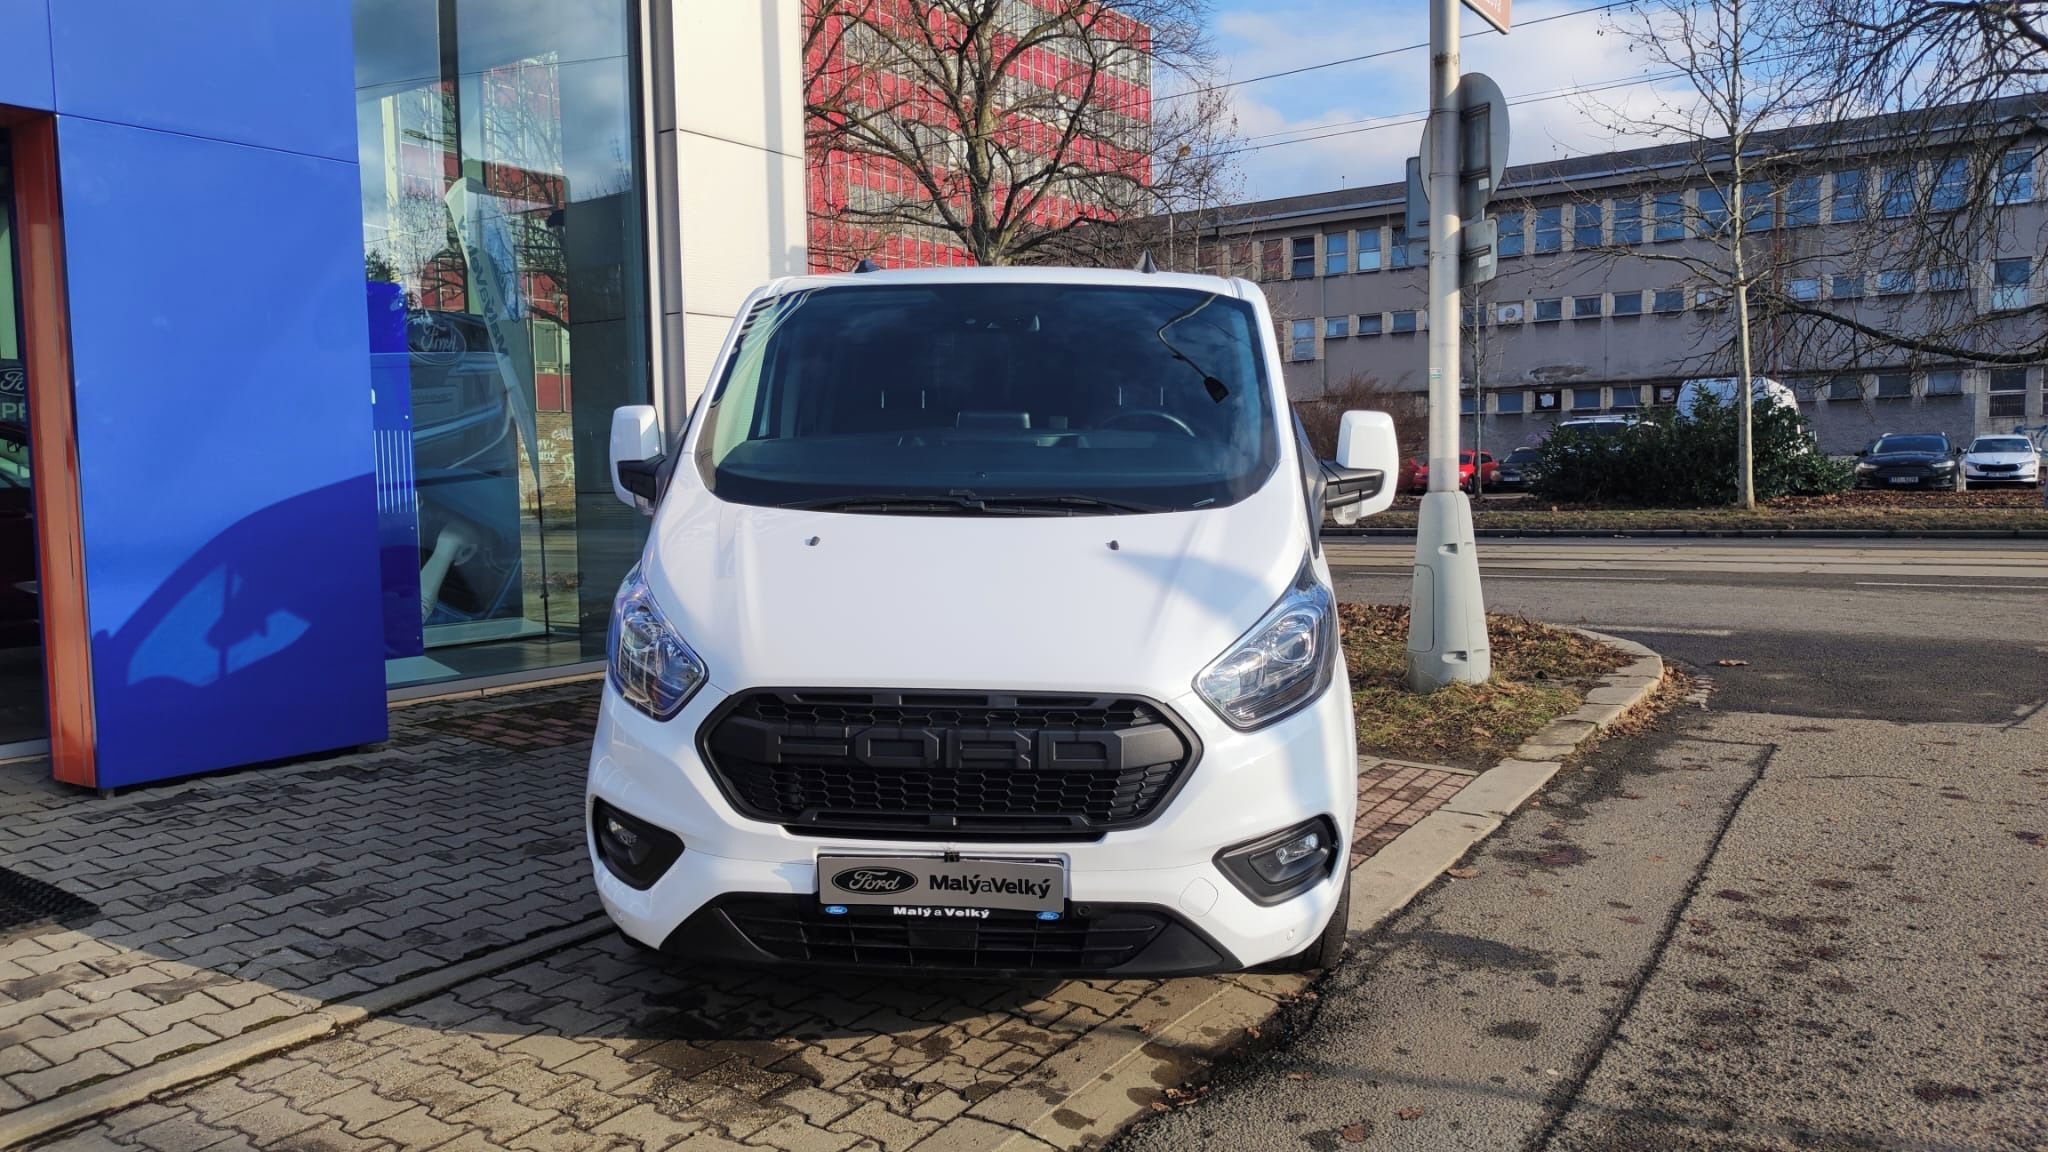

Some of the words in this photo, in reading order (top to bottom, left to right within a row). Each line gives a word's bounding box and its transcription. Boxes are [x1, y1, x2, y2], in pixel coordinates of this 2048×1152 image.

[766, 727, 1122, 769] FORD
[849, 870, 900, 890] Ford
[929, 874, 1050, 899] MalýaVelký
[893, 906, 931, 917] Malý
[934, 909, 942, 917] a
[944, 908, 990, 919] Velký
